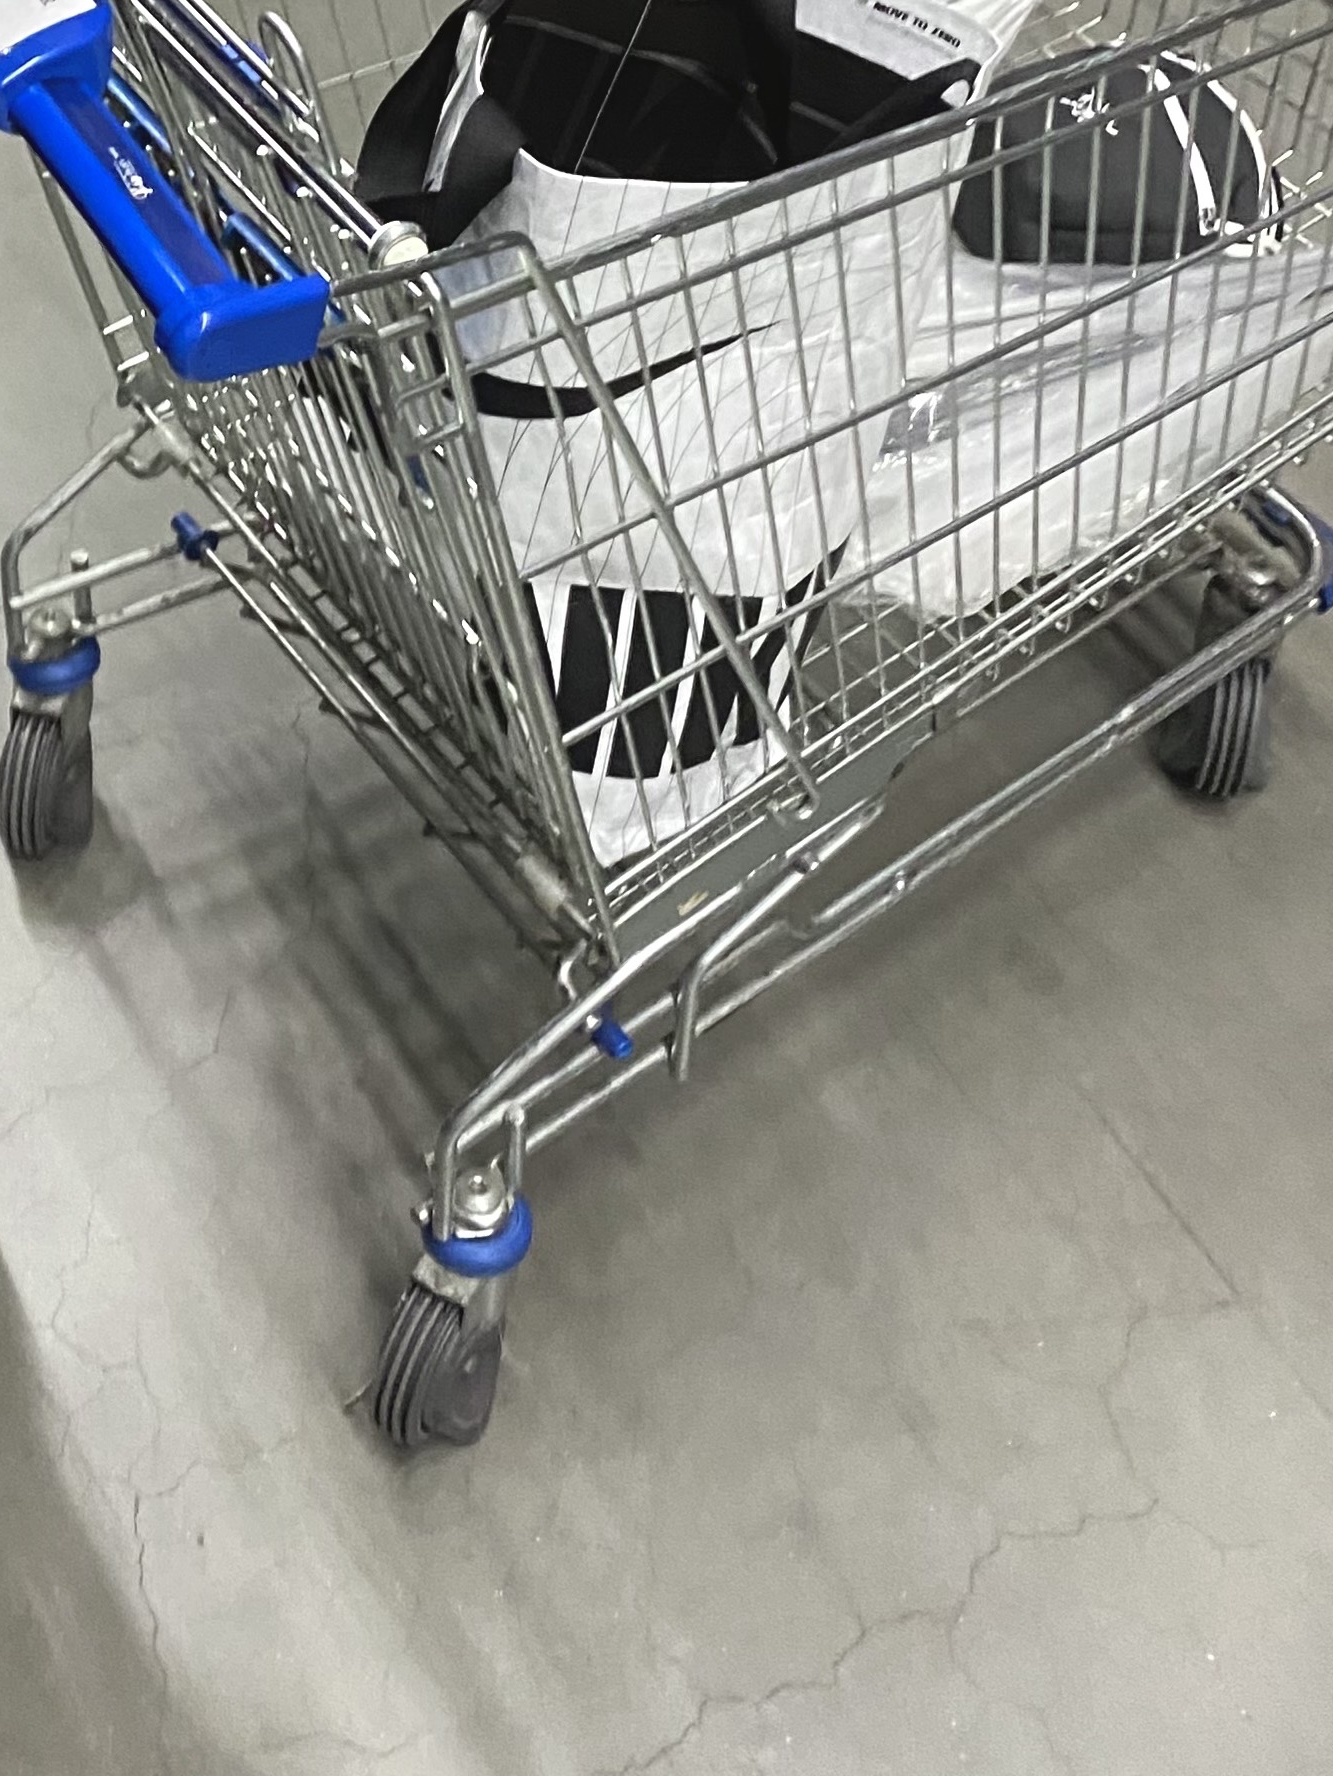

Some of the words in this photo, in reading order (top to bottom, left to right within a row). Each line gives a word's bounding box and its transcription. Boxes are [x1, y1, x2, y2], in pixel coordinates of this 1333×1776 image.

[872, 1, 909, 21] MOVE
[912, 16, 928, 31] TO
[931, 27, 961, 48] ZERO
